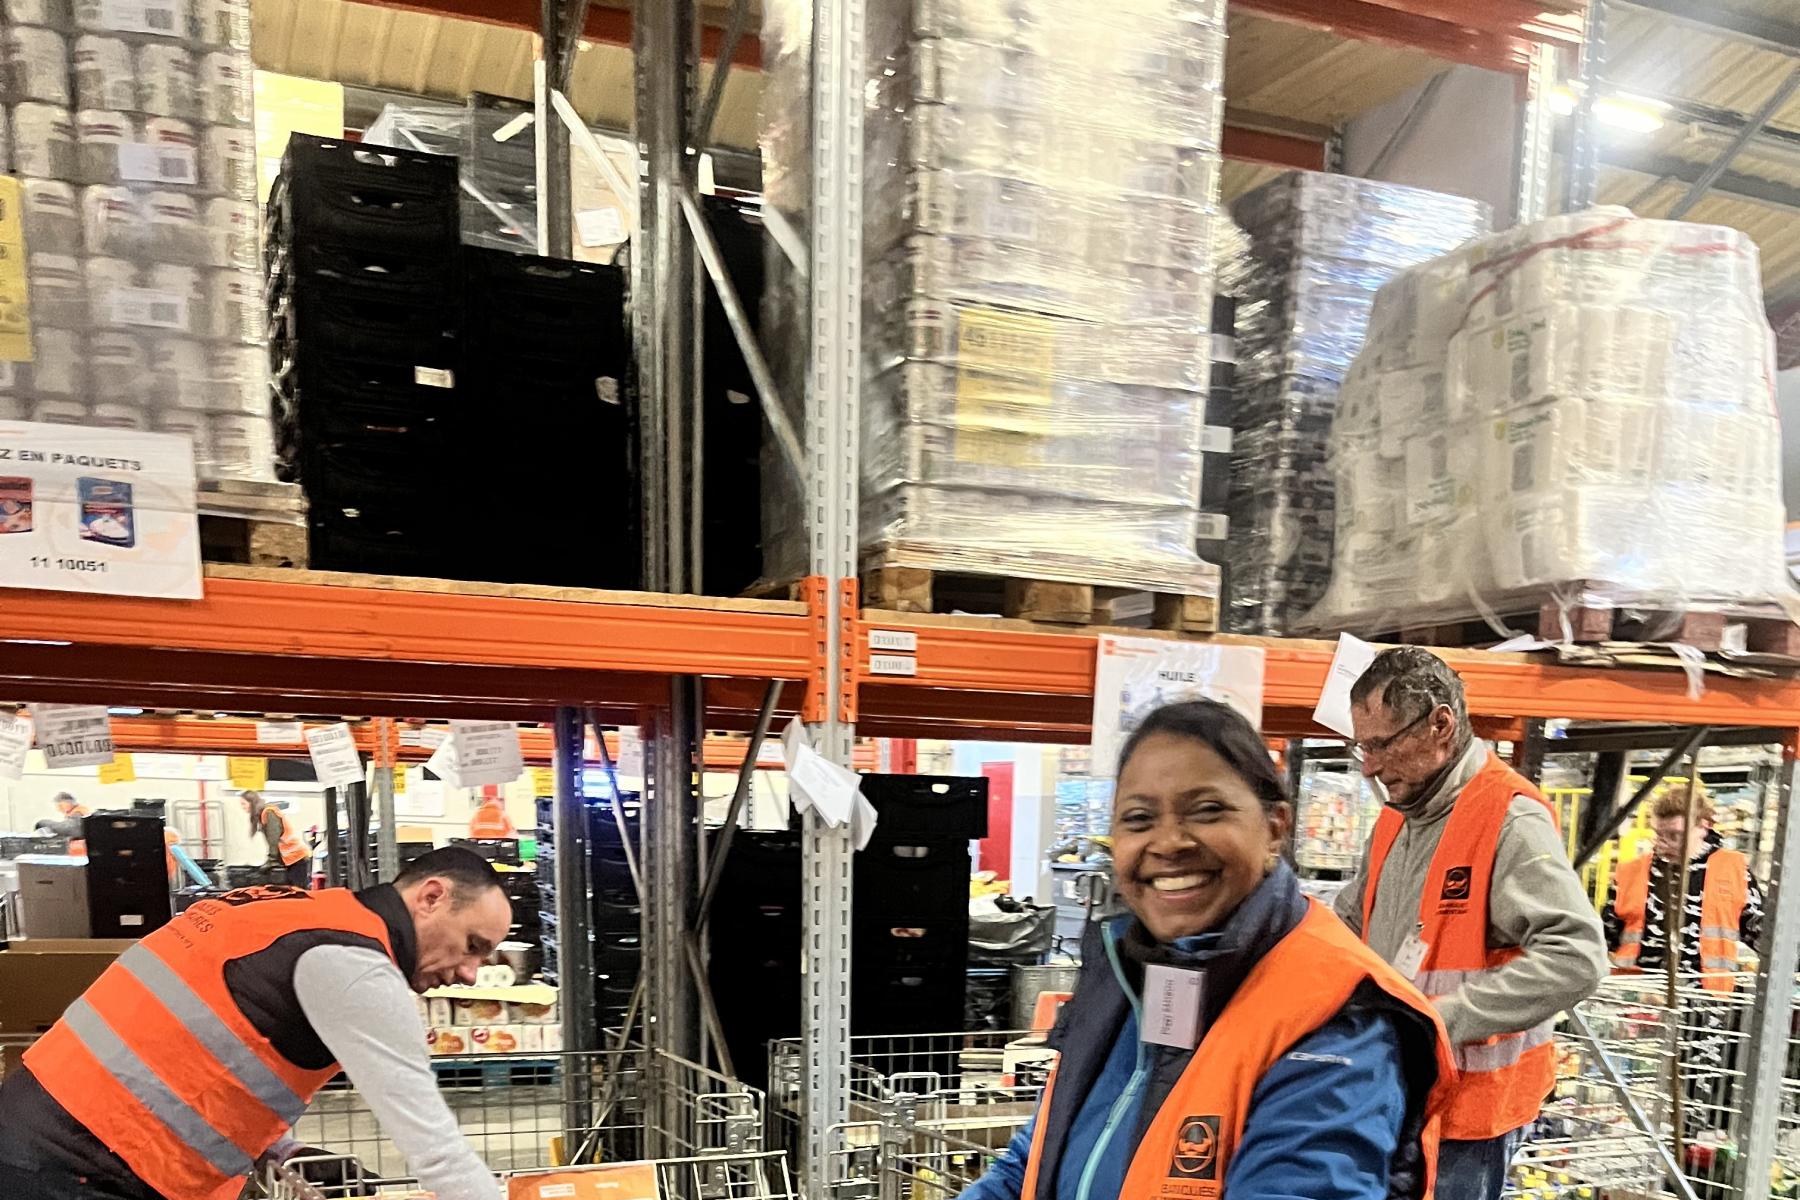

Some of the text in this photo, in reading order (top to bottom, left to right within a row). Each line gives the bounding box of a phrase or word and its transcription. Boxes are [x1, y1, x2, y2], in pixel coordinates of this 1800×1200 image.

[18, 450, 45, 462] EN
[51, 453, 142, 471] PAQUETS
[1157, 670, 1197, 683] HUILE
